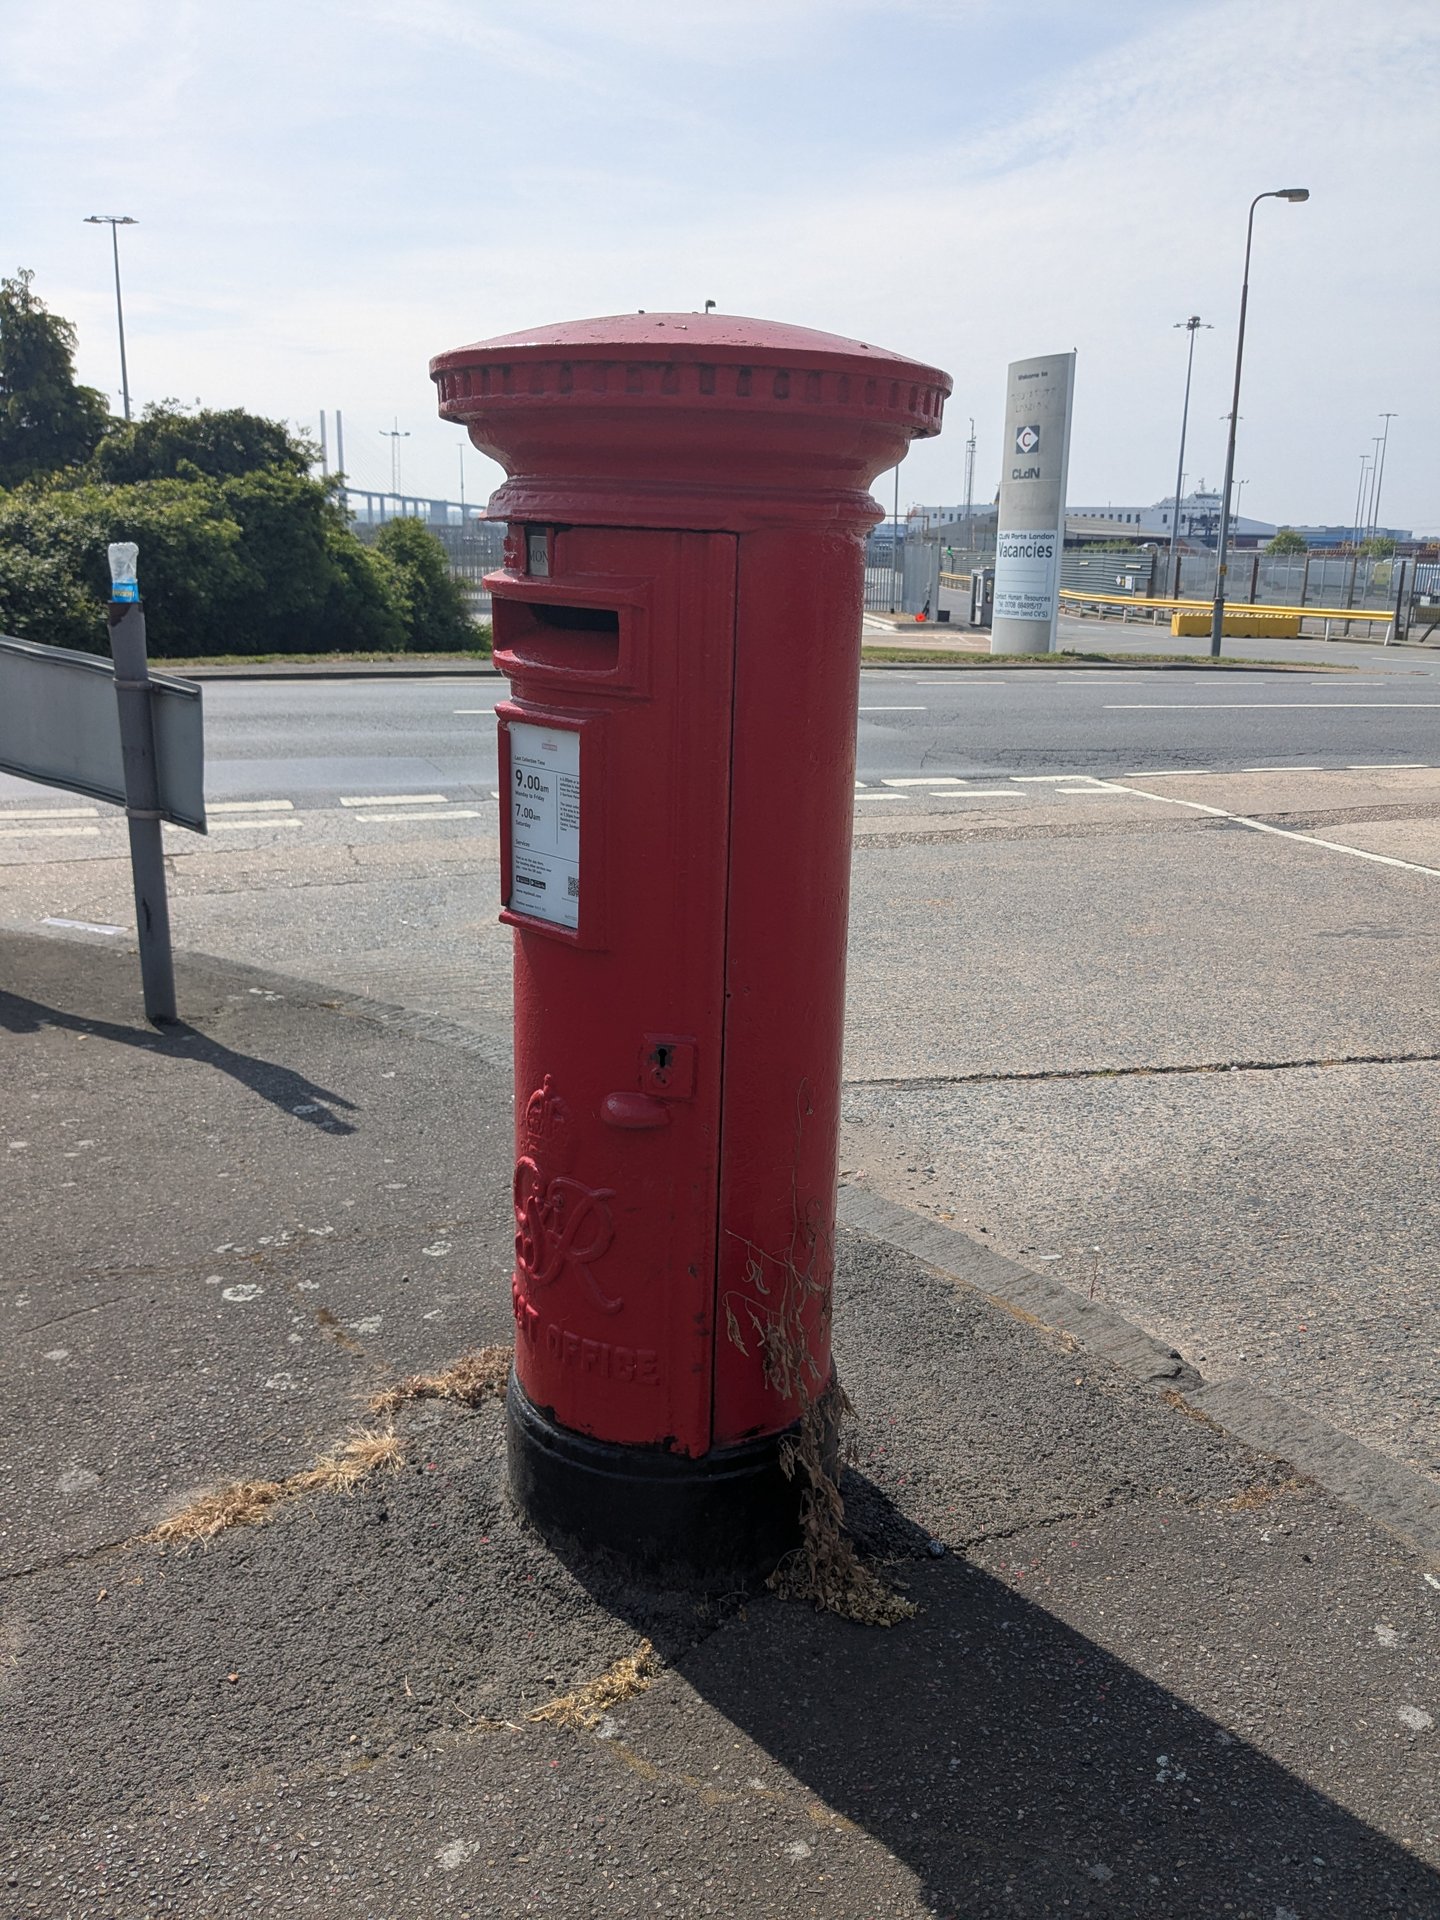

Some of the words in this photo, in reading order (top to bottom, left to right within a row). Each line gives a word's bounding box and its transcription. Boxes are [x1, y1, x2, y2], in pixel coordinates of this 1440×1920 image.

[1022, 432, 1032, 447] C
[1012, 467, 1040, 480] CLdN
[999, 541, 1053, 558] Vacancies
[529, 550, 549, 563] MON
[1024, 594, 1051, 603] Resources
[515, 769, 549, 793] 9.00am
[515, 790, 528, 799] Monday
[534, 794, 545, 802] Friday
[515, 803, 541, 821] 7.00am
[515, 820, 531, 828] Saturday
[515, 839, 530, 847] Services
[546, 1323, 660, 1386] OFFICE
